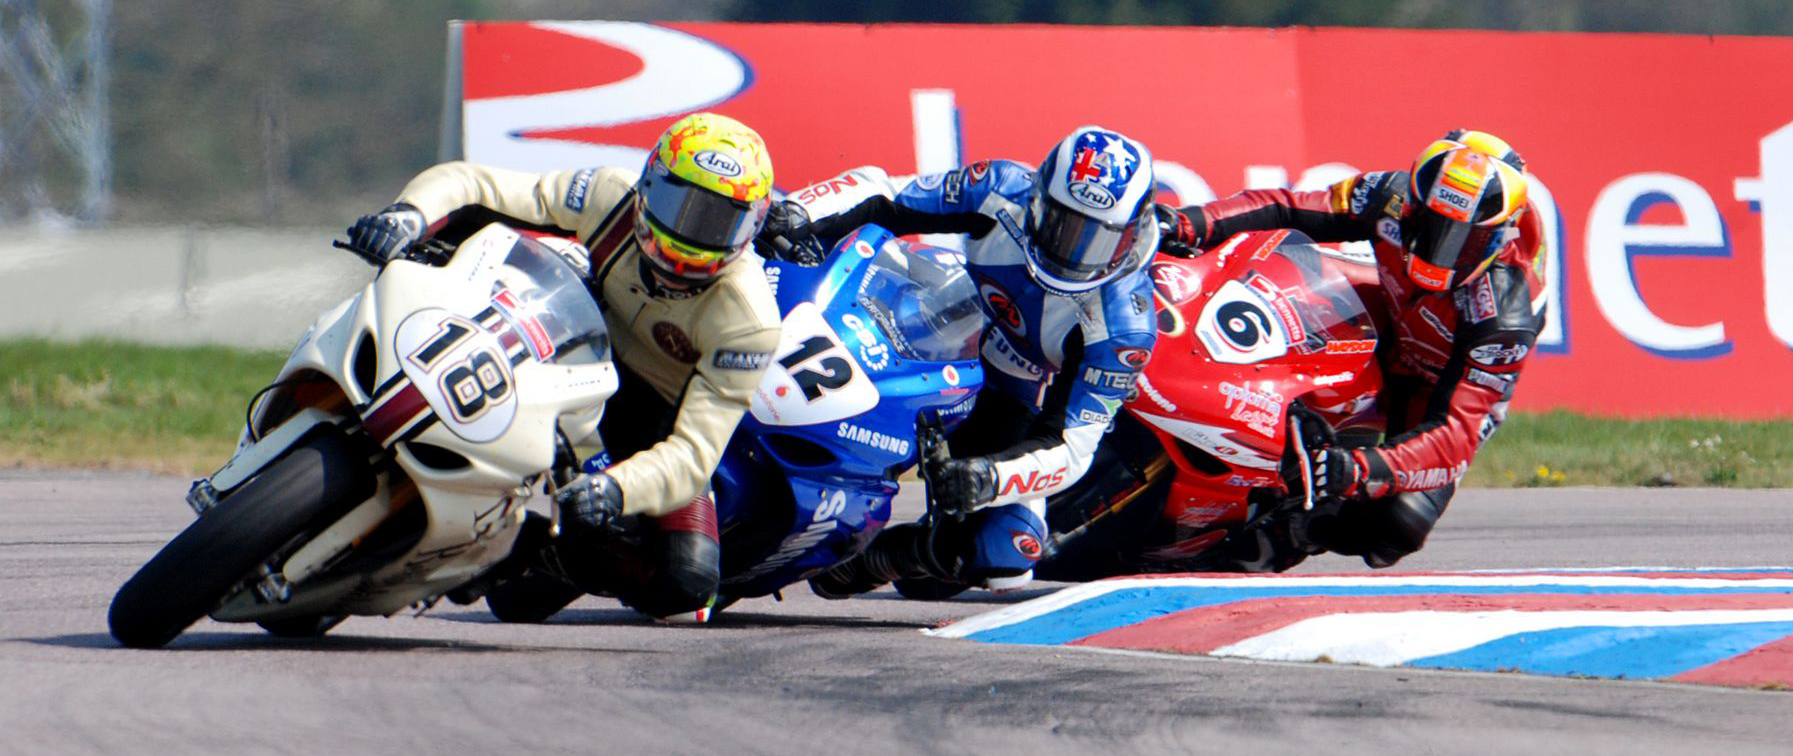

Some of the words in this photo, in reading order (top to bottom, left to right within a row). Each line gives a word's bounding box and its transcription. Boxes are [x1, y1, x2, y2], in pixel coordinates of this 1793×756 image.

[699, 152, 736, 172] Arai
[1078, 183, 1110, 205] Arai
[1439, 188, 1470, 208] SHOEI
[1214, 301, 1273, 351] 6
[1275, 296, 1302, 341] bennetts
[405, 317, 513, 424] 18
[778, 335, 853, 403] 12
[837, 421, 909, 456] SAMSUNG
